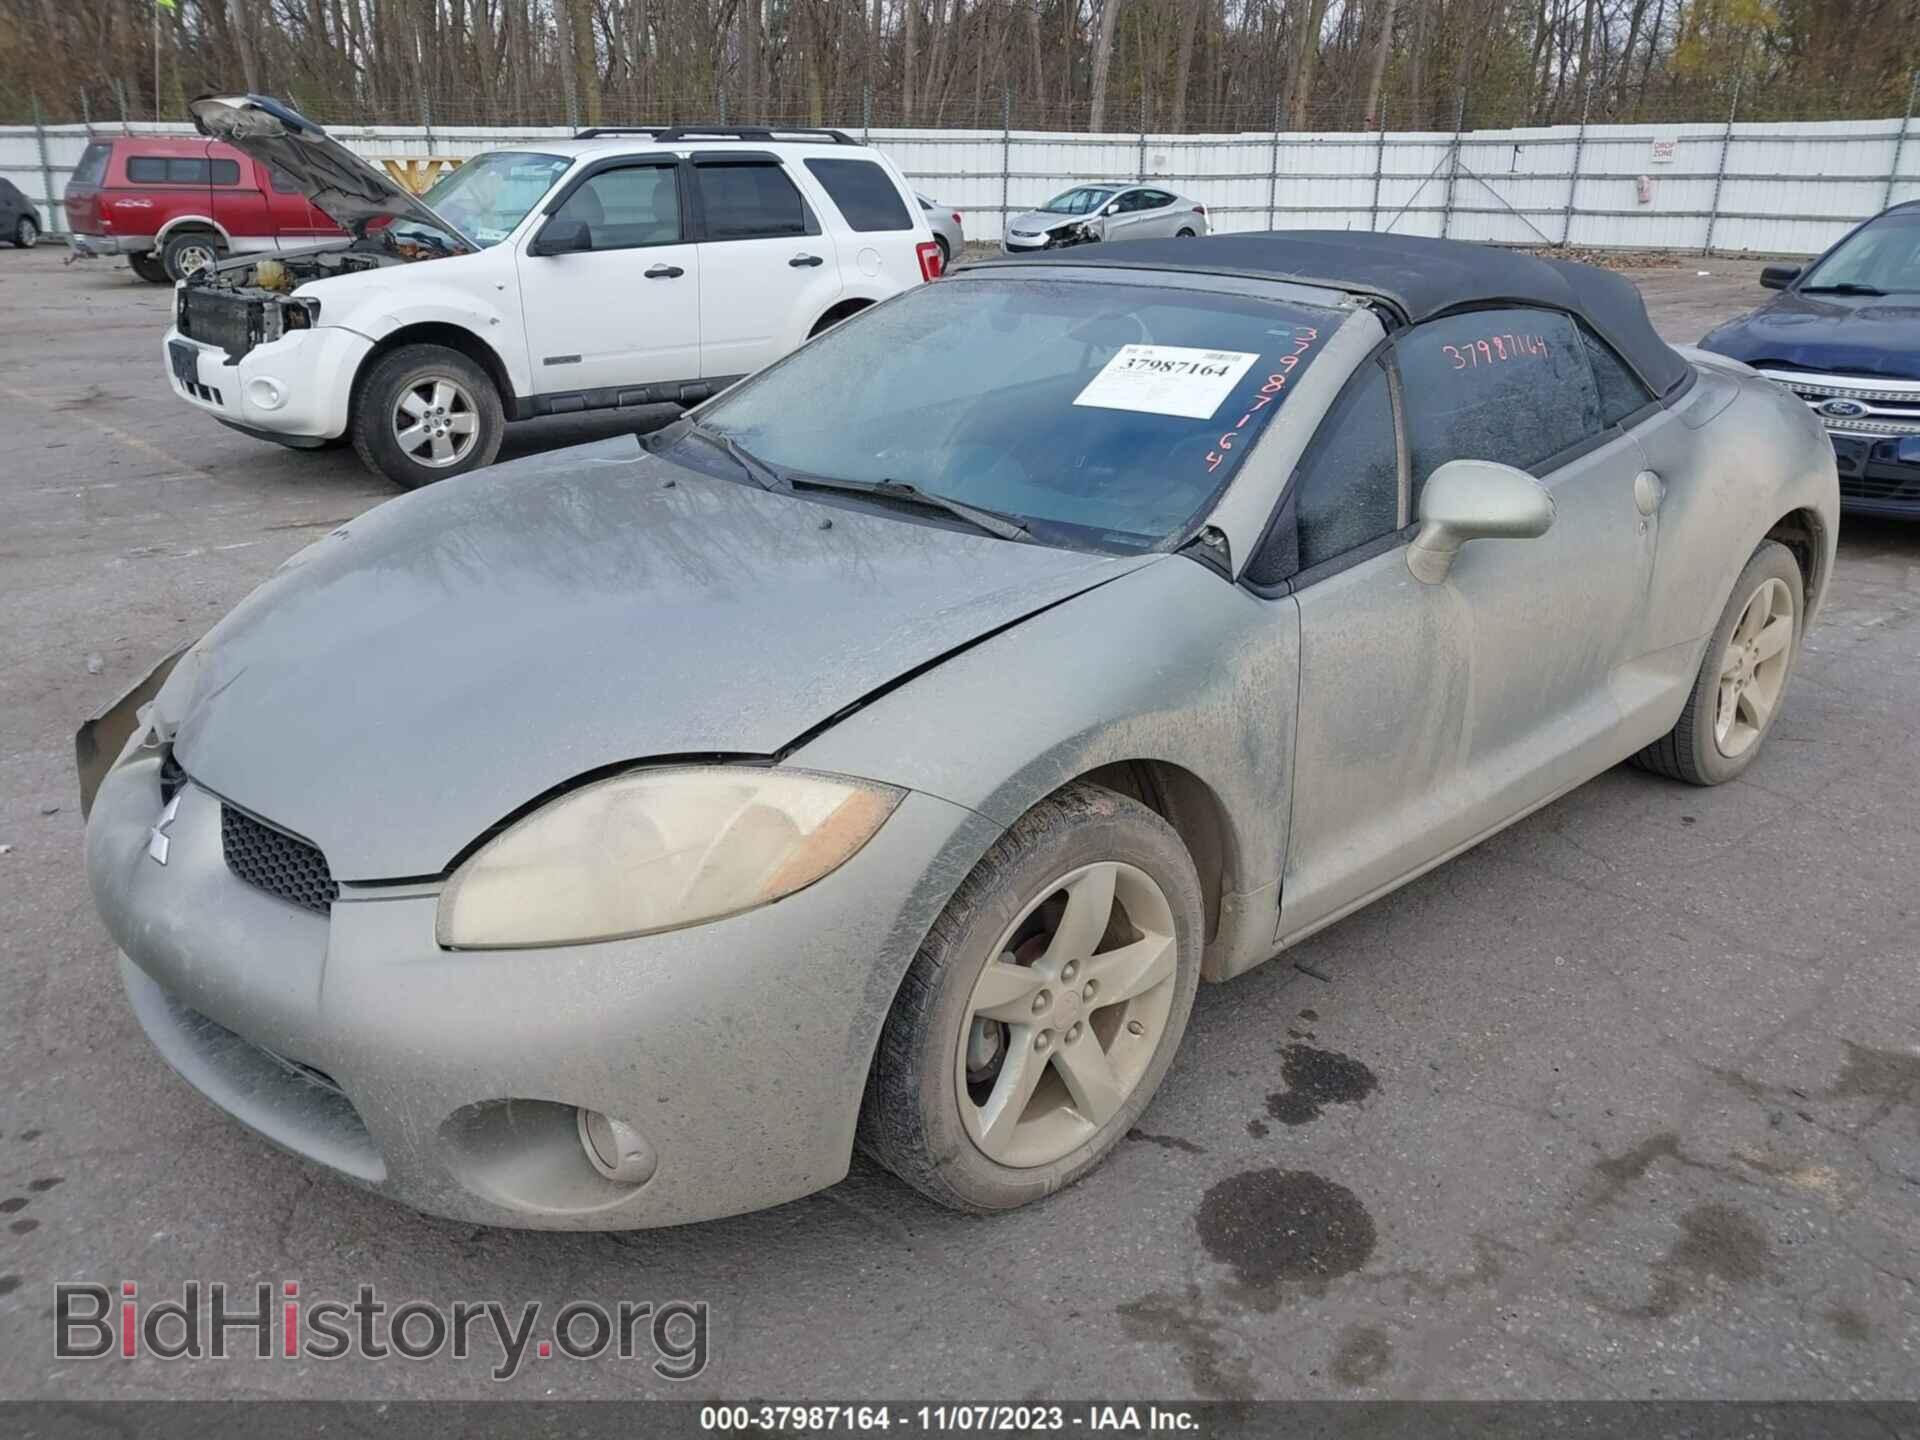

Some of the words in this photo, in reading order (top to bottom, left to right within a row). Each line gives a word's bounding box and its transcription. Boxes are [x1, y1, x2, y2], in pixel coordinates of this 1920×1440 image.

[1119, 357, 1230, 377] 37987164
[1442, 334, 1549, 370] 37987164
[1205, 326, 1318, 473] 37987164
